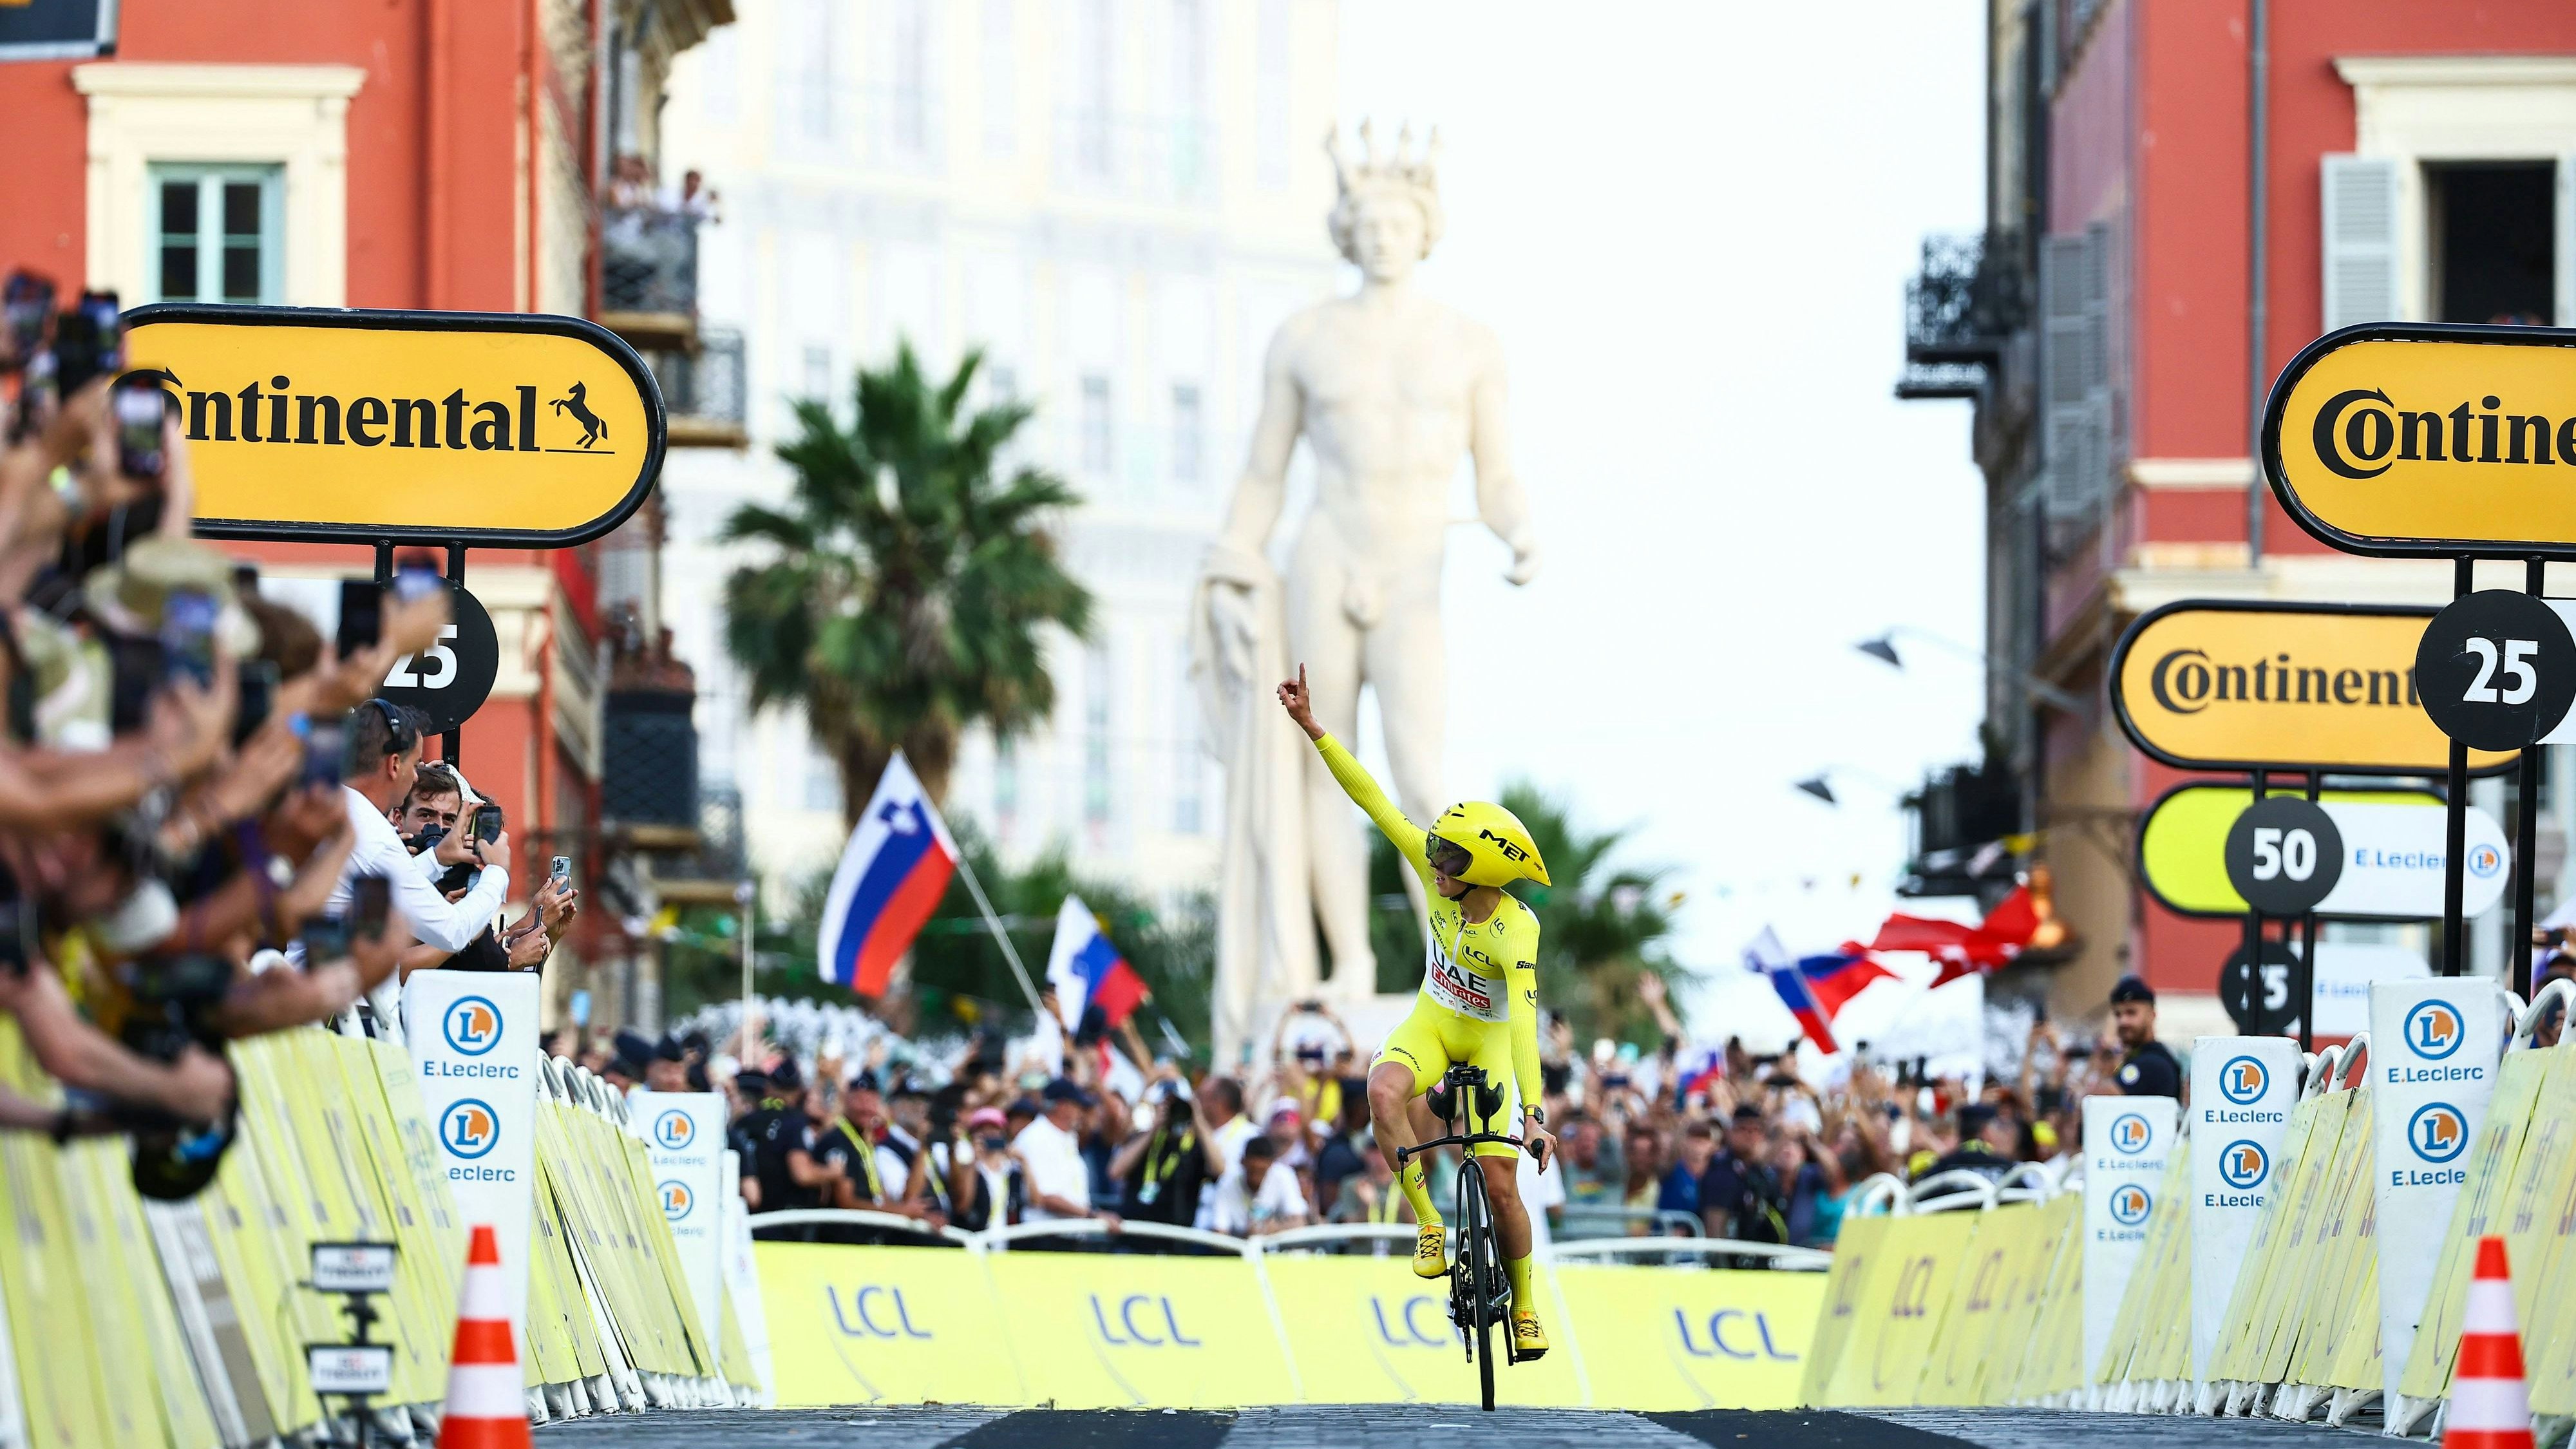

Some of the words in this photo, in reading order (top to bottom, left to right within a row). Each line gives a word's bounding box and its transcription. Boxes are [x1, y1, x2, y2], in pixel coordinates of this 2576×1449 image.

[108, 368, 540, 452] ntinental
[2463, 637, 2539, 705] 25
[1479, 829, 1531, 862] MET
[2253, 828, 2317, 881] 50
[1429, 915, 1447, 951] Santini
[1493, 918, 1506, 935] LCL
[1433, 940, 1487, 996] UAE
[1465, 946, 1495, 967] LCL
[1516, 960, 1536, 970] San
[1432, 963, 1489, 1009] Emirates
[424, 1061, 518, 1079] E.Leclerc
[1390, 1047, 1421, 1072] Santini
[2388, 1065, 2484, 1084] E.Leclerc
[2204, 1109, 2284, 1123] E.Leclerc
[447, 1166, 516, 1182] eclerc
[827, 1285, 933, 1339] LCL
[1089, 1294, 1202, 1347] LCL
[1674, 1307, 1799, 1361] LCL
